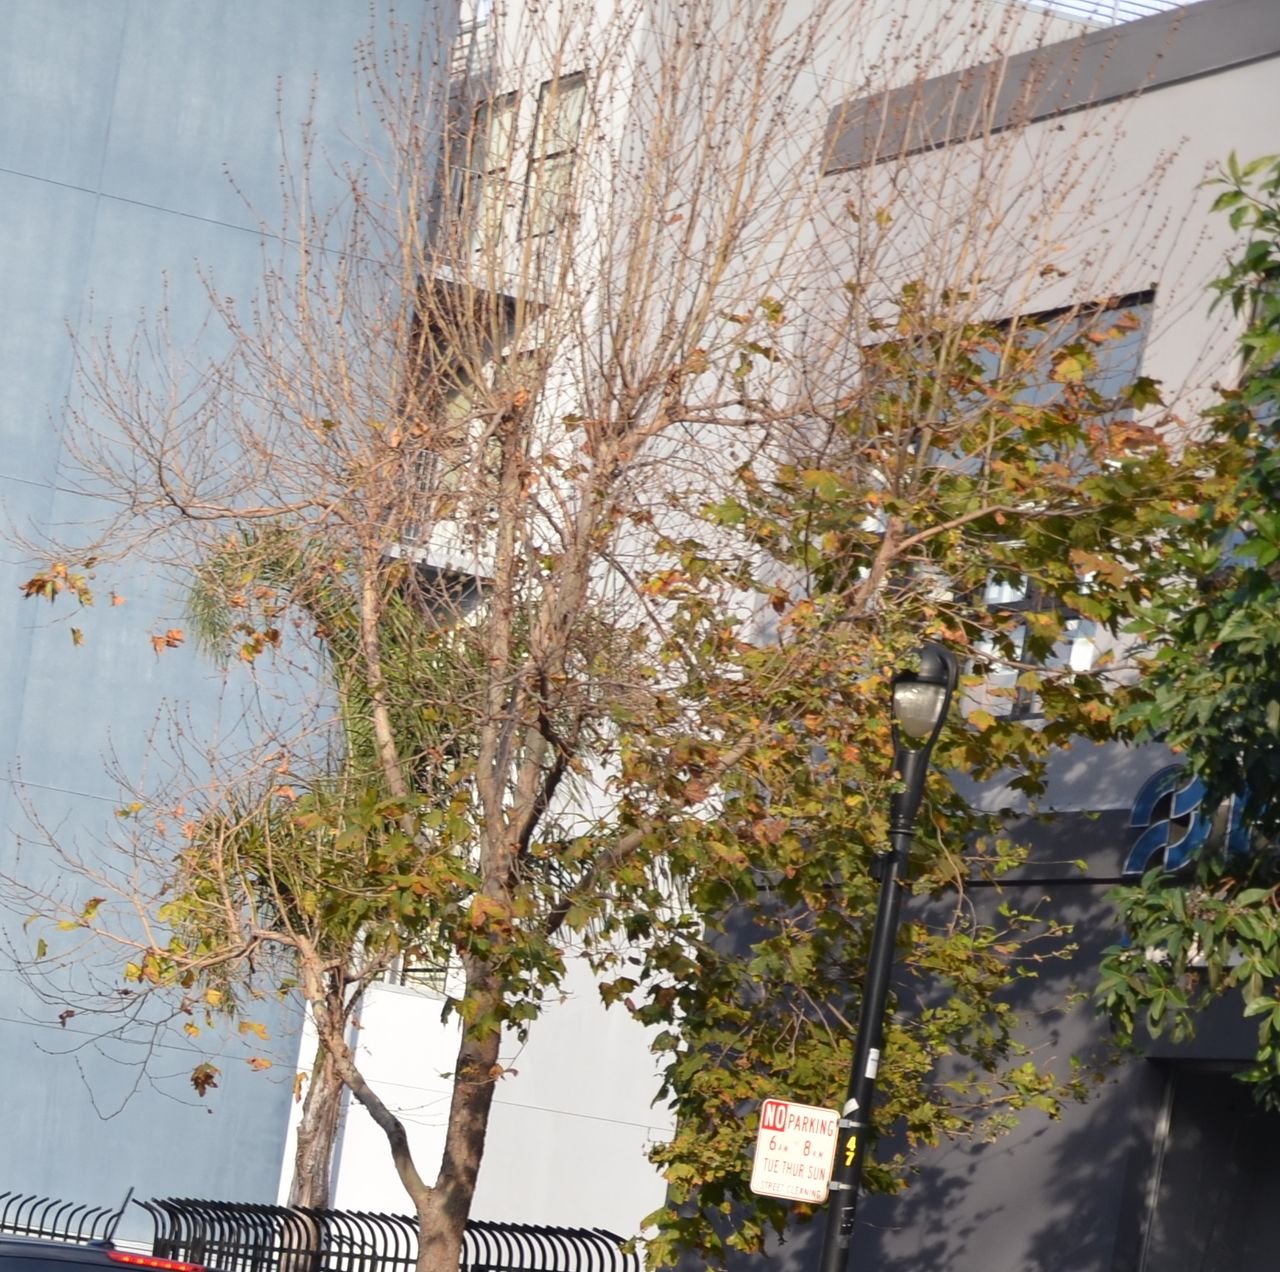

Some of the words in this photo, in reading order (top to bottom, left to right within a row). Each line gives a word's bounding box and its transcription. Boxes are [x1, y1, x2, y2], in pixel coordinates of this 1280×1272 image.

[764, 1103, 786, 1129] NO
[787, 1113, 835, 1137] PARKING
[763, 1158, 780, 1174] TUE
[783, 1160, 806, 1178] THUR
[807, 1165, 826, 1181] SUN
[760, 1180, 785, 1192] STREET
[786, 1184, 822, 1199] CLEANING
